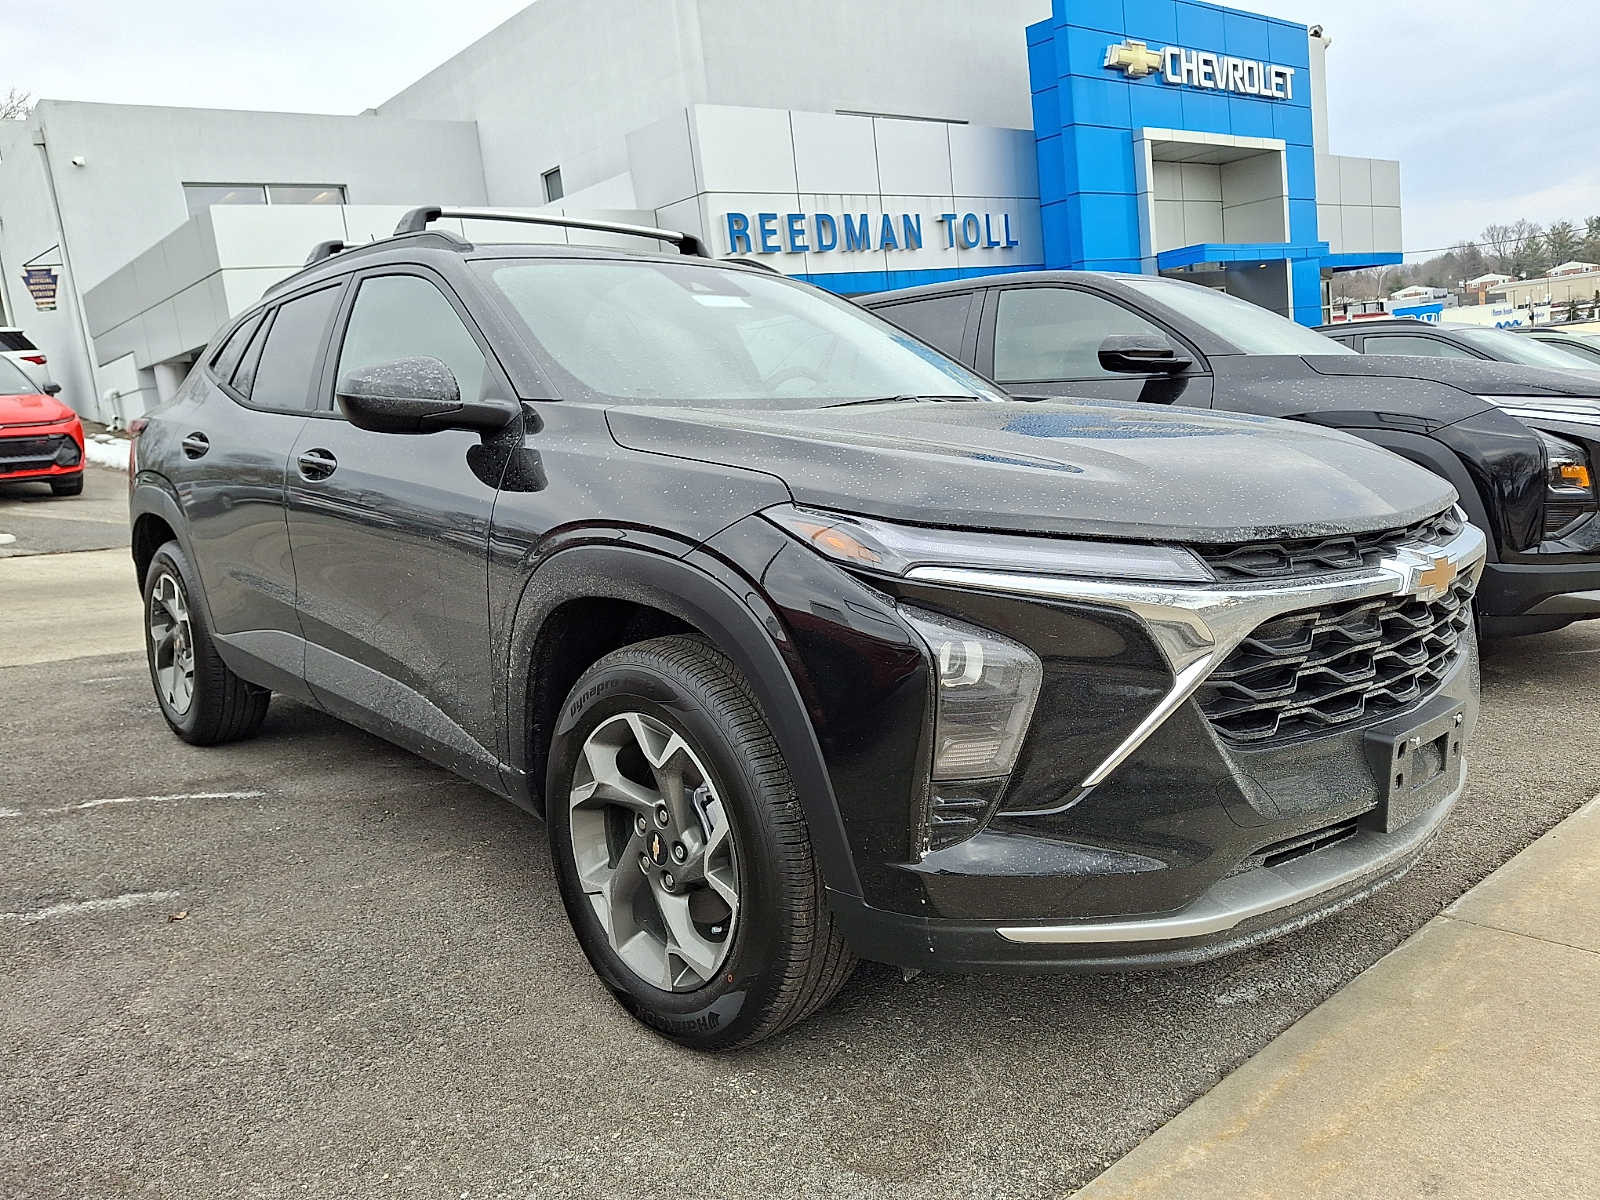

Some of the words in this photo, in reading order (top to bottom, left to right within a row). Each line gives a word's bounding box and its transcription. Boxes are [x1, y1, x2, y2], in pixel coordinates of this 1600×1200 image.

[1163, 46, 1294, 100] CHEVROLET
[724, 212, 923, 253] REEDMAN
[938, 213, 1018, 249] TOLL
